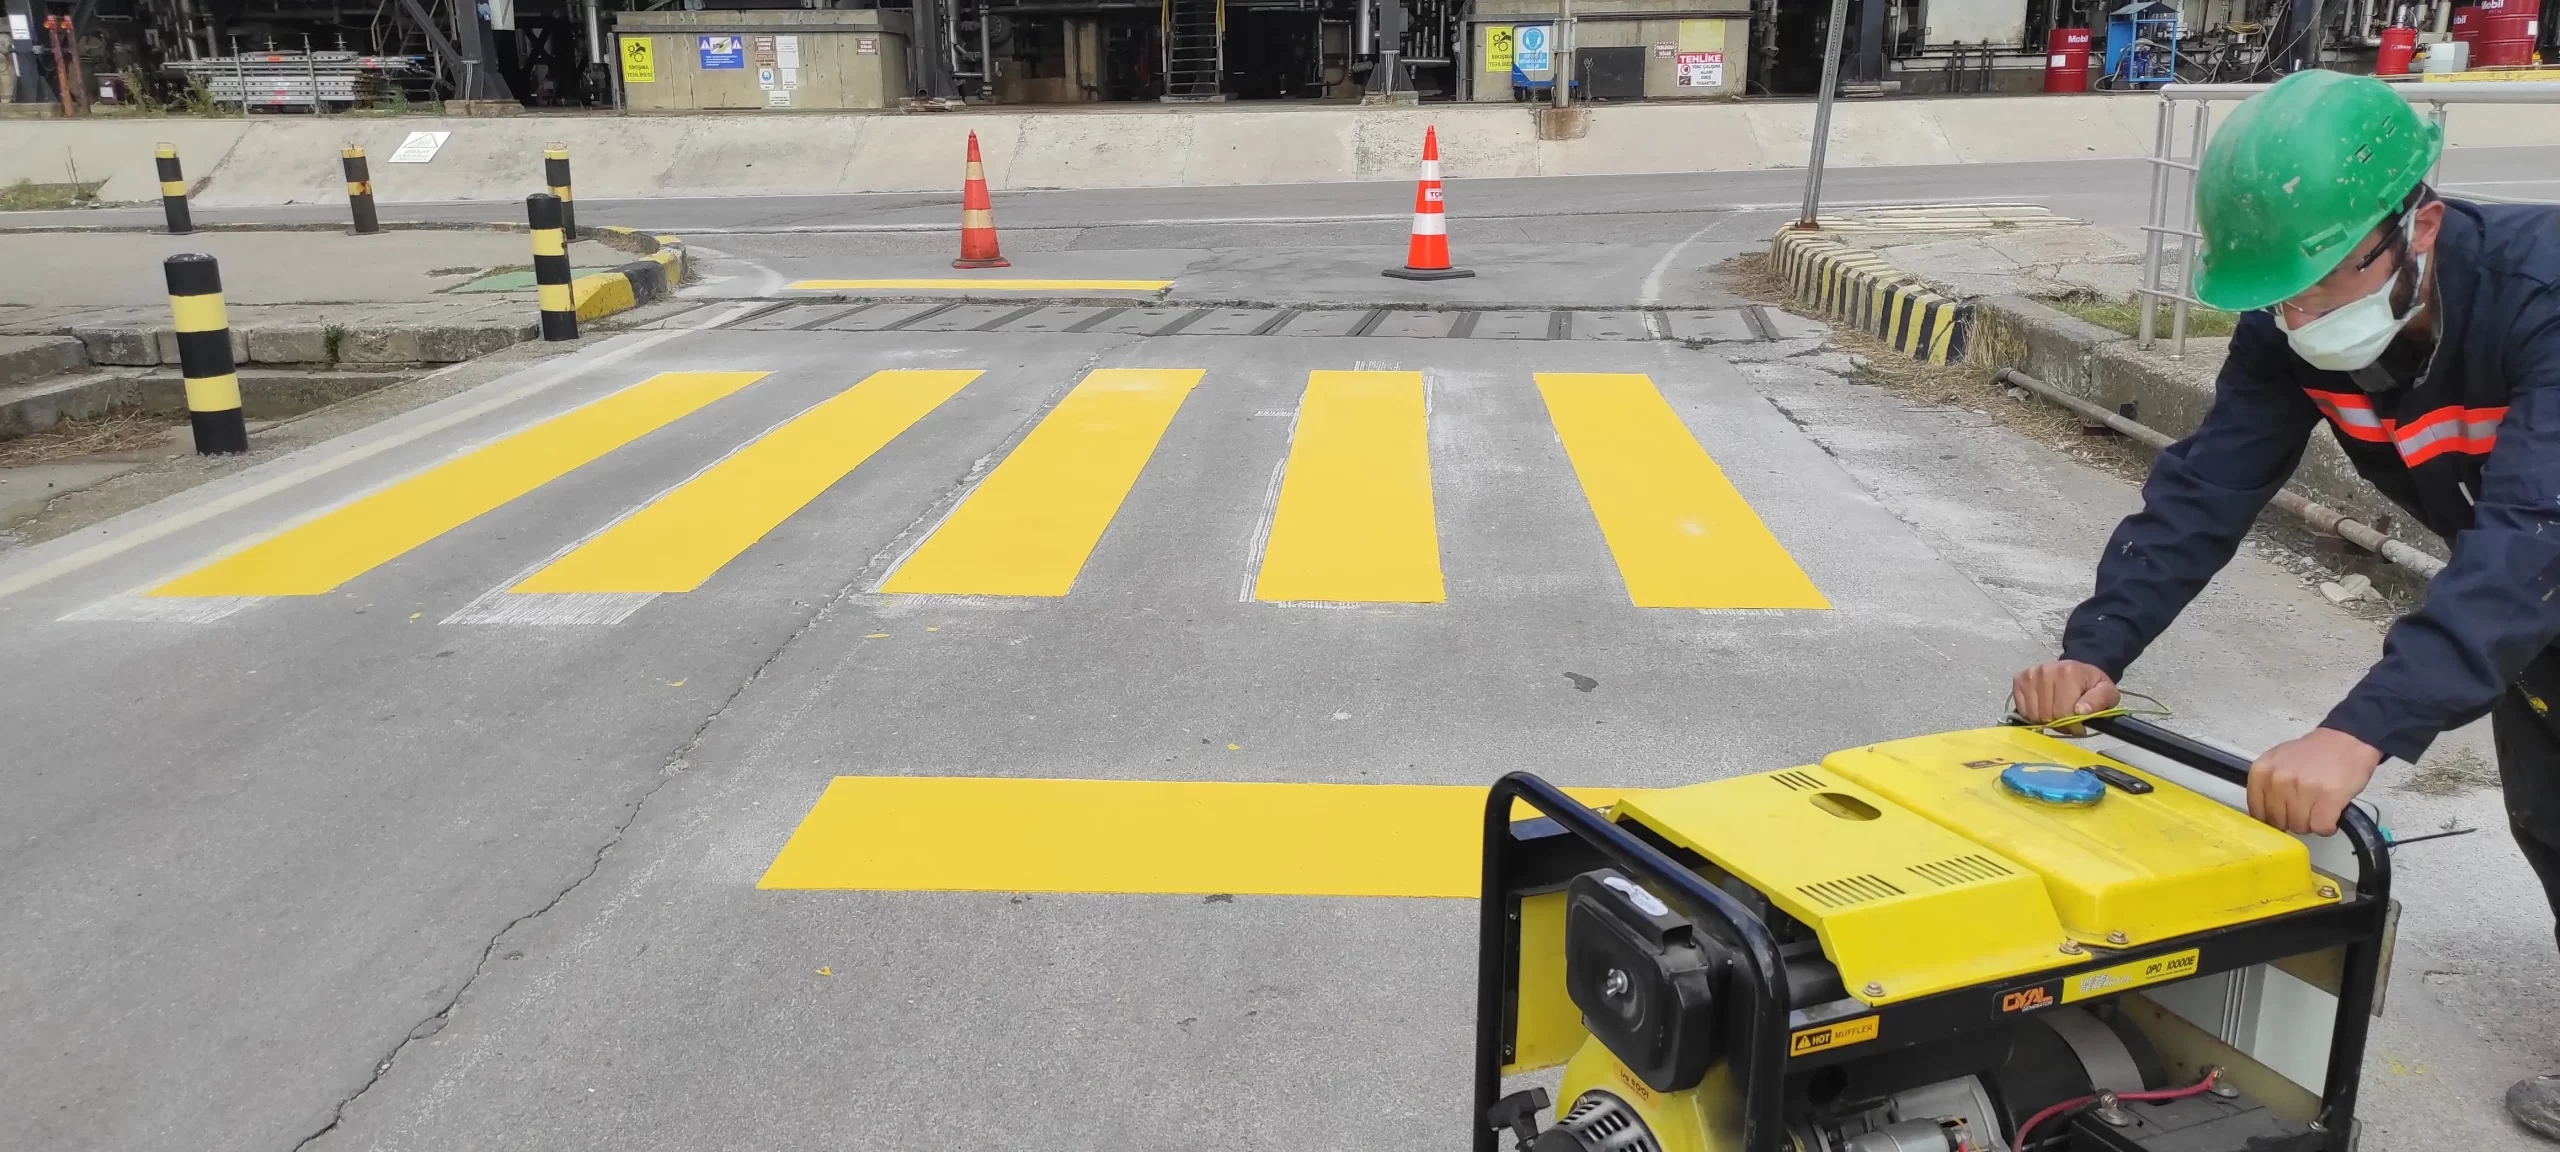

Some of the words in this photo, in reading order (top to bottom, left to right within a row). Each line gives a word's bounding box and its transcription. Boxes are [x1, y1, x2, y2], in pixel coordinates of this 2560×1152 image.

[2068, 35, 2089, 43] Mobil
[1680, 53, 1721, 63] TEHLİKE
[1811, 1033, 1831, 1046] HOT
[1834, 1024, 1873, 1039] MUFFLER
